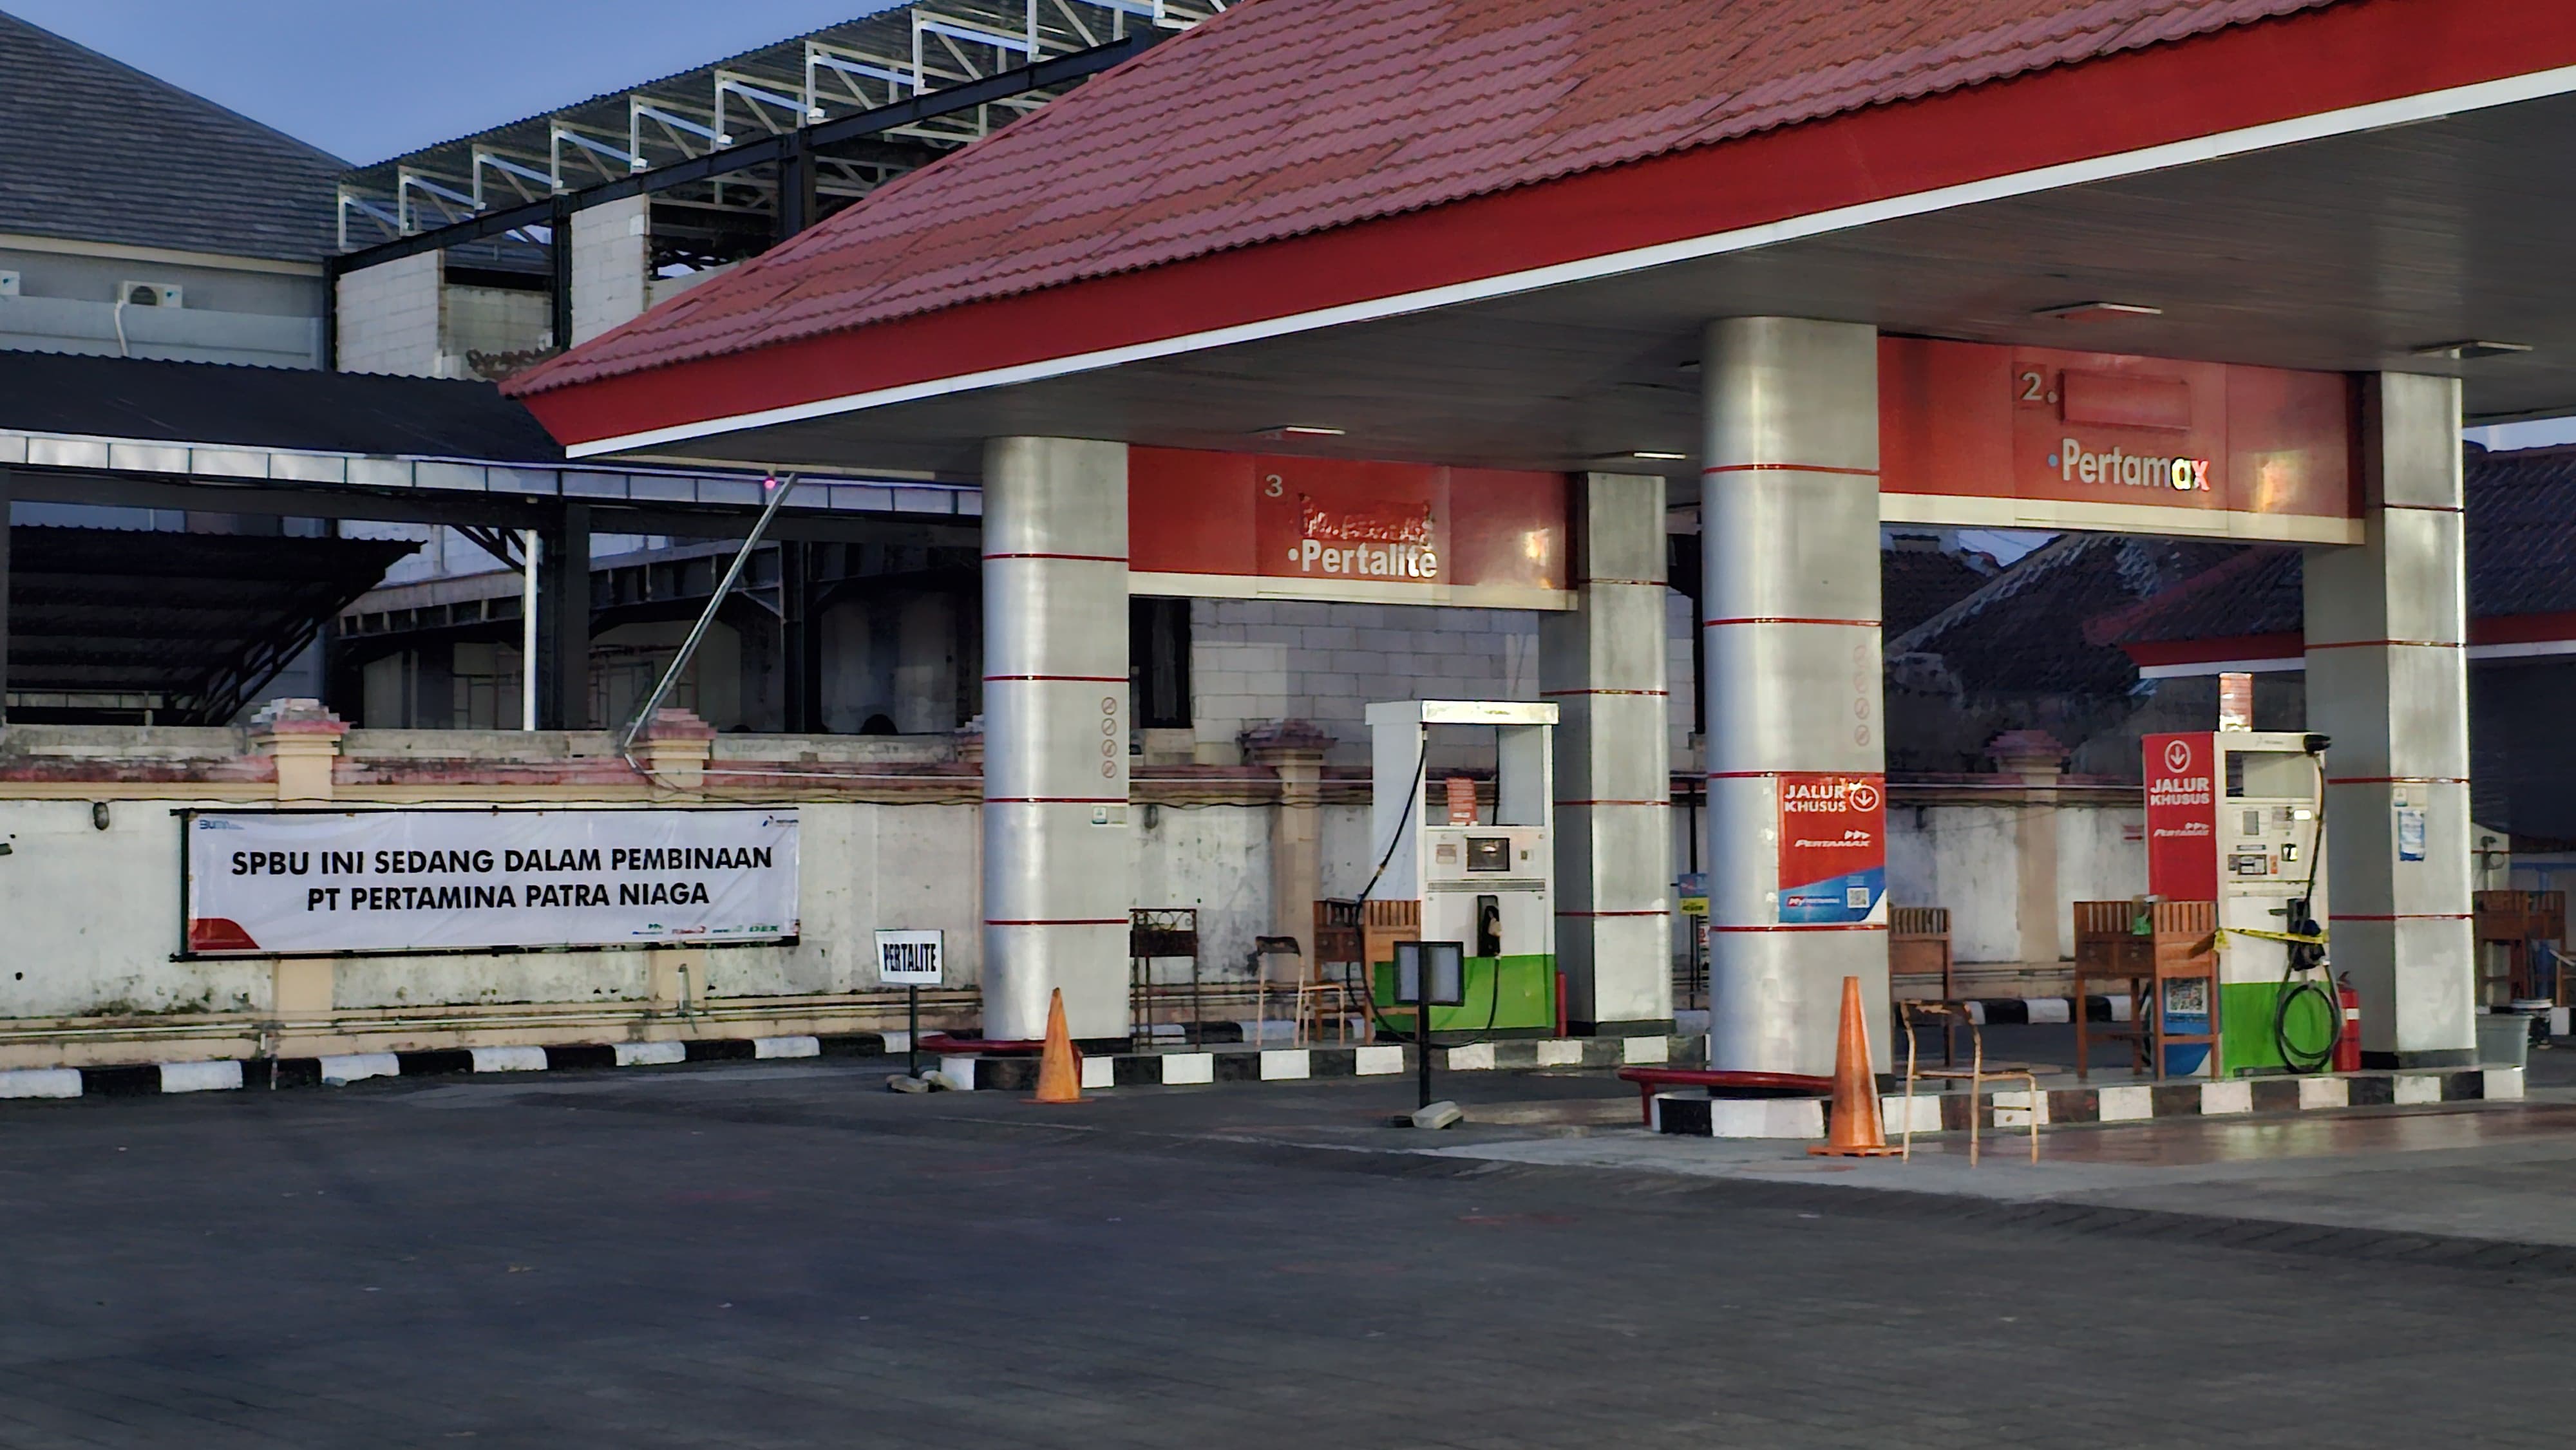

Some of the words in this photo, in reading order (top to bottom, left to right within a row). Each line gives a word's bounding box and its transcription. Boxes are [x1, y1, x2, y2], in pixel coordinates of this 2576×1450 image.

[2063, 438, 2210, 491] Pertamax
[1264, 474, 1283, 498] 3
[1302, 538, 1438, 578] Pertalite
[1784, 784, 1846, 799] JALUR
[2150, 777, 2210, 793] JALUR
[1784, 800, 1847, 813] KHUSUS
[2150, 793, 2210, 806] KHUSUS
[231, 851, 309, 876] SPBU
[321, 851, 365, 875] INI
[374, 849, 495, 874] SEDANG
[504, 849, 601, 872] DALAM
[611, 846, 773, 871] PEMBINAAN
[307, 888, 341, 912] PT
[351, 885, 516, 911] PERTAMINA
[526, 883, 611, 908] PATRA
[619, 882, 710, 906] NIAGA
[882, 943, 936, 972] PERTALITE
